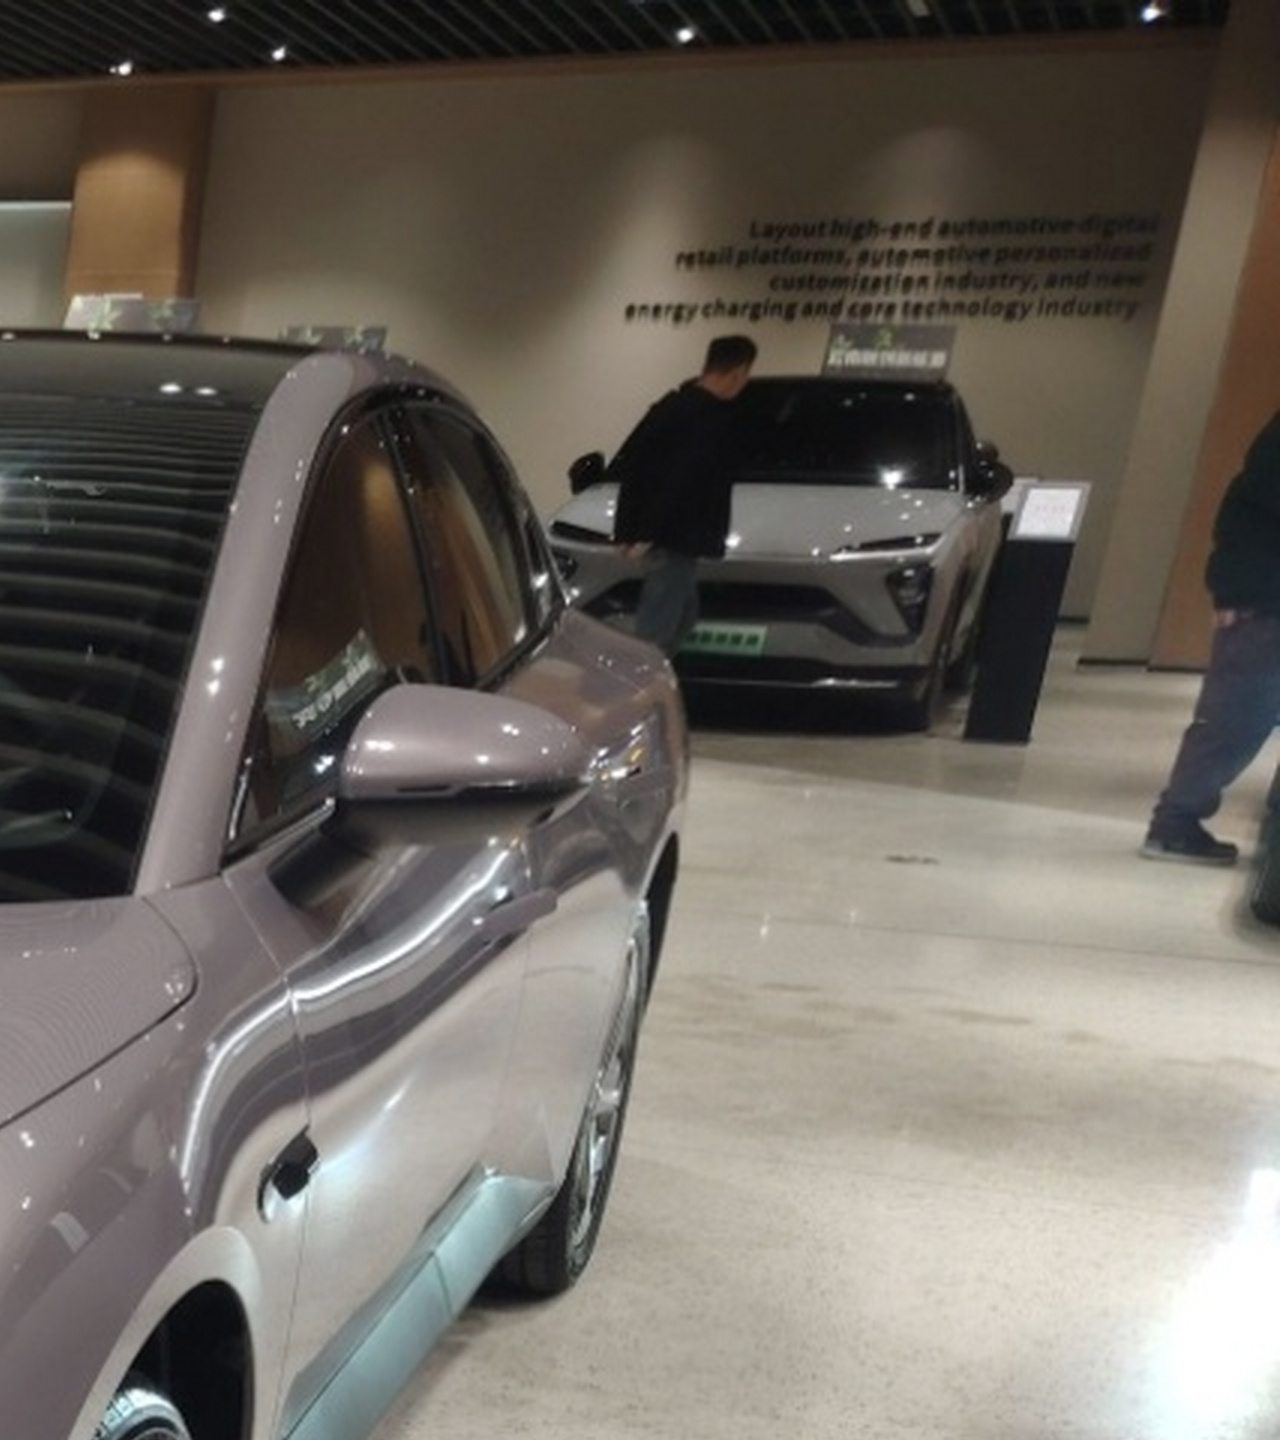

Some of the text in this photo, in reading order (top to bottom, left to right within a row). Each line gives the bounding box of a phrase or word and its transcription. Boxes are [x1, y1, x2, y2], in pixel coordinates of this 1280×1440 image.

[750, 219, 827, 243] Layout
[830, 216, 934, 242] high-end
[676, 246, 734, 270] retail
[736, 245, 852, 269] platforms,
[857, 245, 993, 268] automotive
[934, 270, 1038, 294] industry,
[1043, 269, 1089, 291] and
[625, 297, 1140, 323] energy charging and core technology industry
